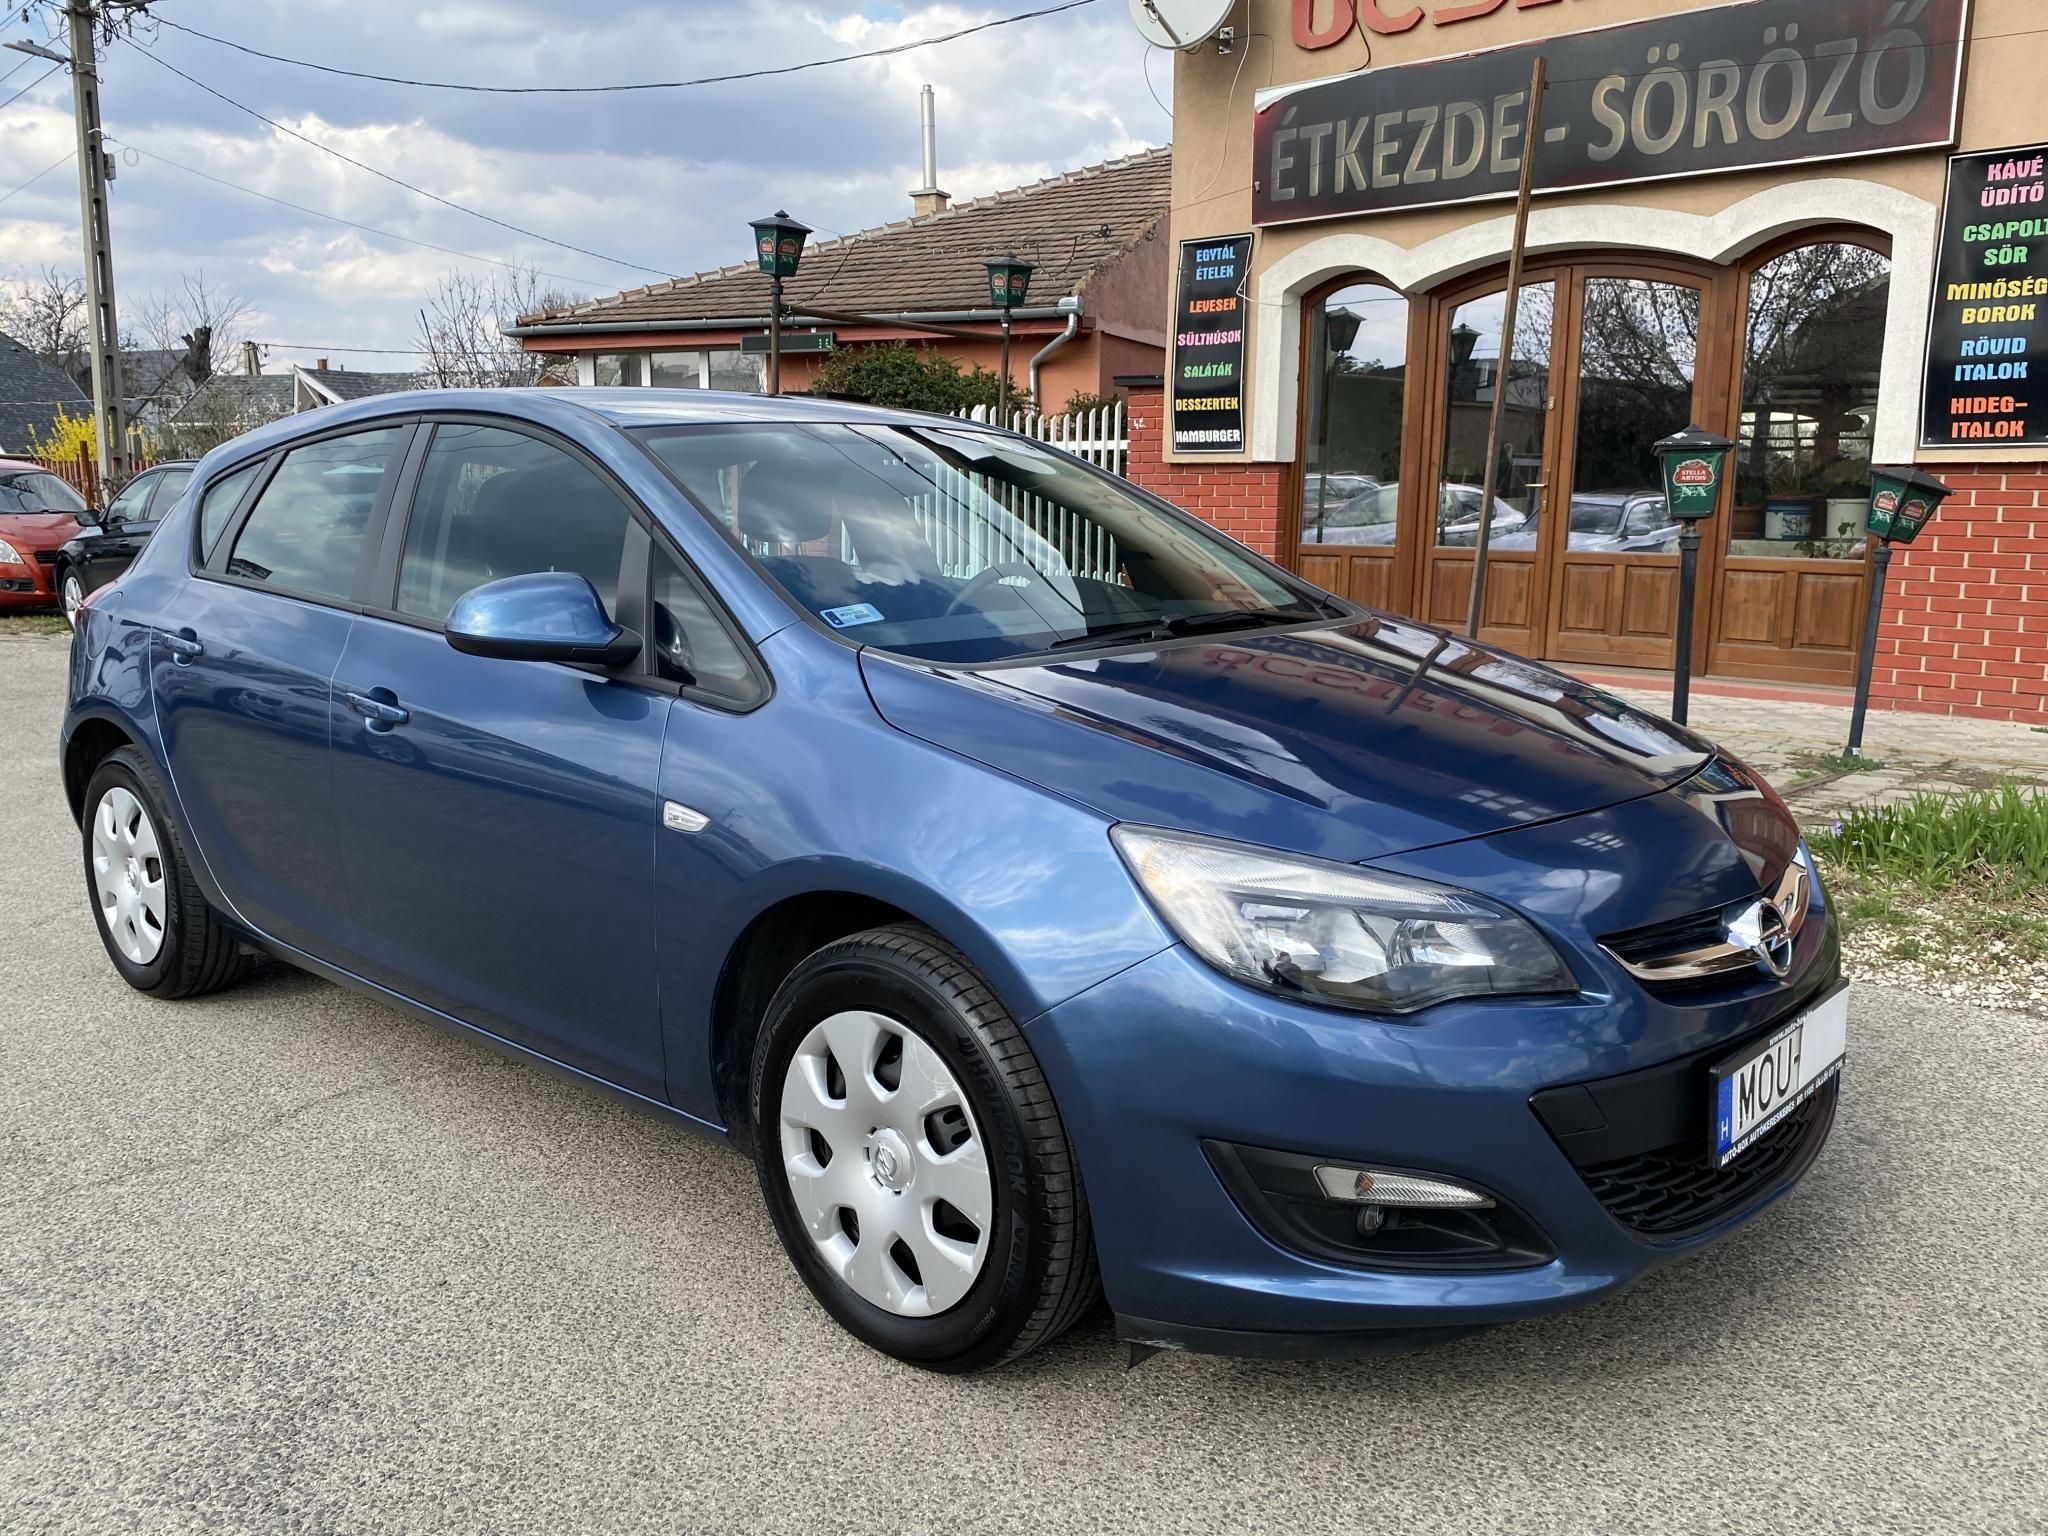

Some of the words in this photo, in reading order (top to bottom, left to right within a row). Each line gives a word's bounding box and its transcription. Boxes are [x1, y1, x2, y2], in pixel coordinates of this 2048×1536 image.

[1270, 92, 1525, 202] ÉTKEZDE
[1587, 0, 1927, 162] SÖRÖZŐ
[1987, 155, 2044, 181] KÁVÉ
[1981, 180, 2045, 207] ÜDÍTŐ
[1196, 246, 1236, 262] EGYTÁL
[1984, 244, 2028, 266] SÖR
[1196, 265, 1234, 281] ÉTELEK
[1190, 297, 1237, 313] LEVESEK
[1961, 304, 2036, 324] BOROK
[1178, 330, 1241, 346] SÜLTHÚSOK
[1961, 336, 2027, 357] RÖVID
[1184, 362, 1233, 378] SALÁTÁK
[1954, 361, 2028, 381] ITALOK
[1176, 397, 1239, 412] DESSZERTEK
[1176, 428, 1241, 443] HAMBURGER
[1951, 420, 2025, 439] ITALOK
[1721, 1117, 1730, 1141] H
